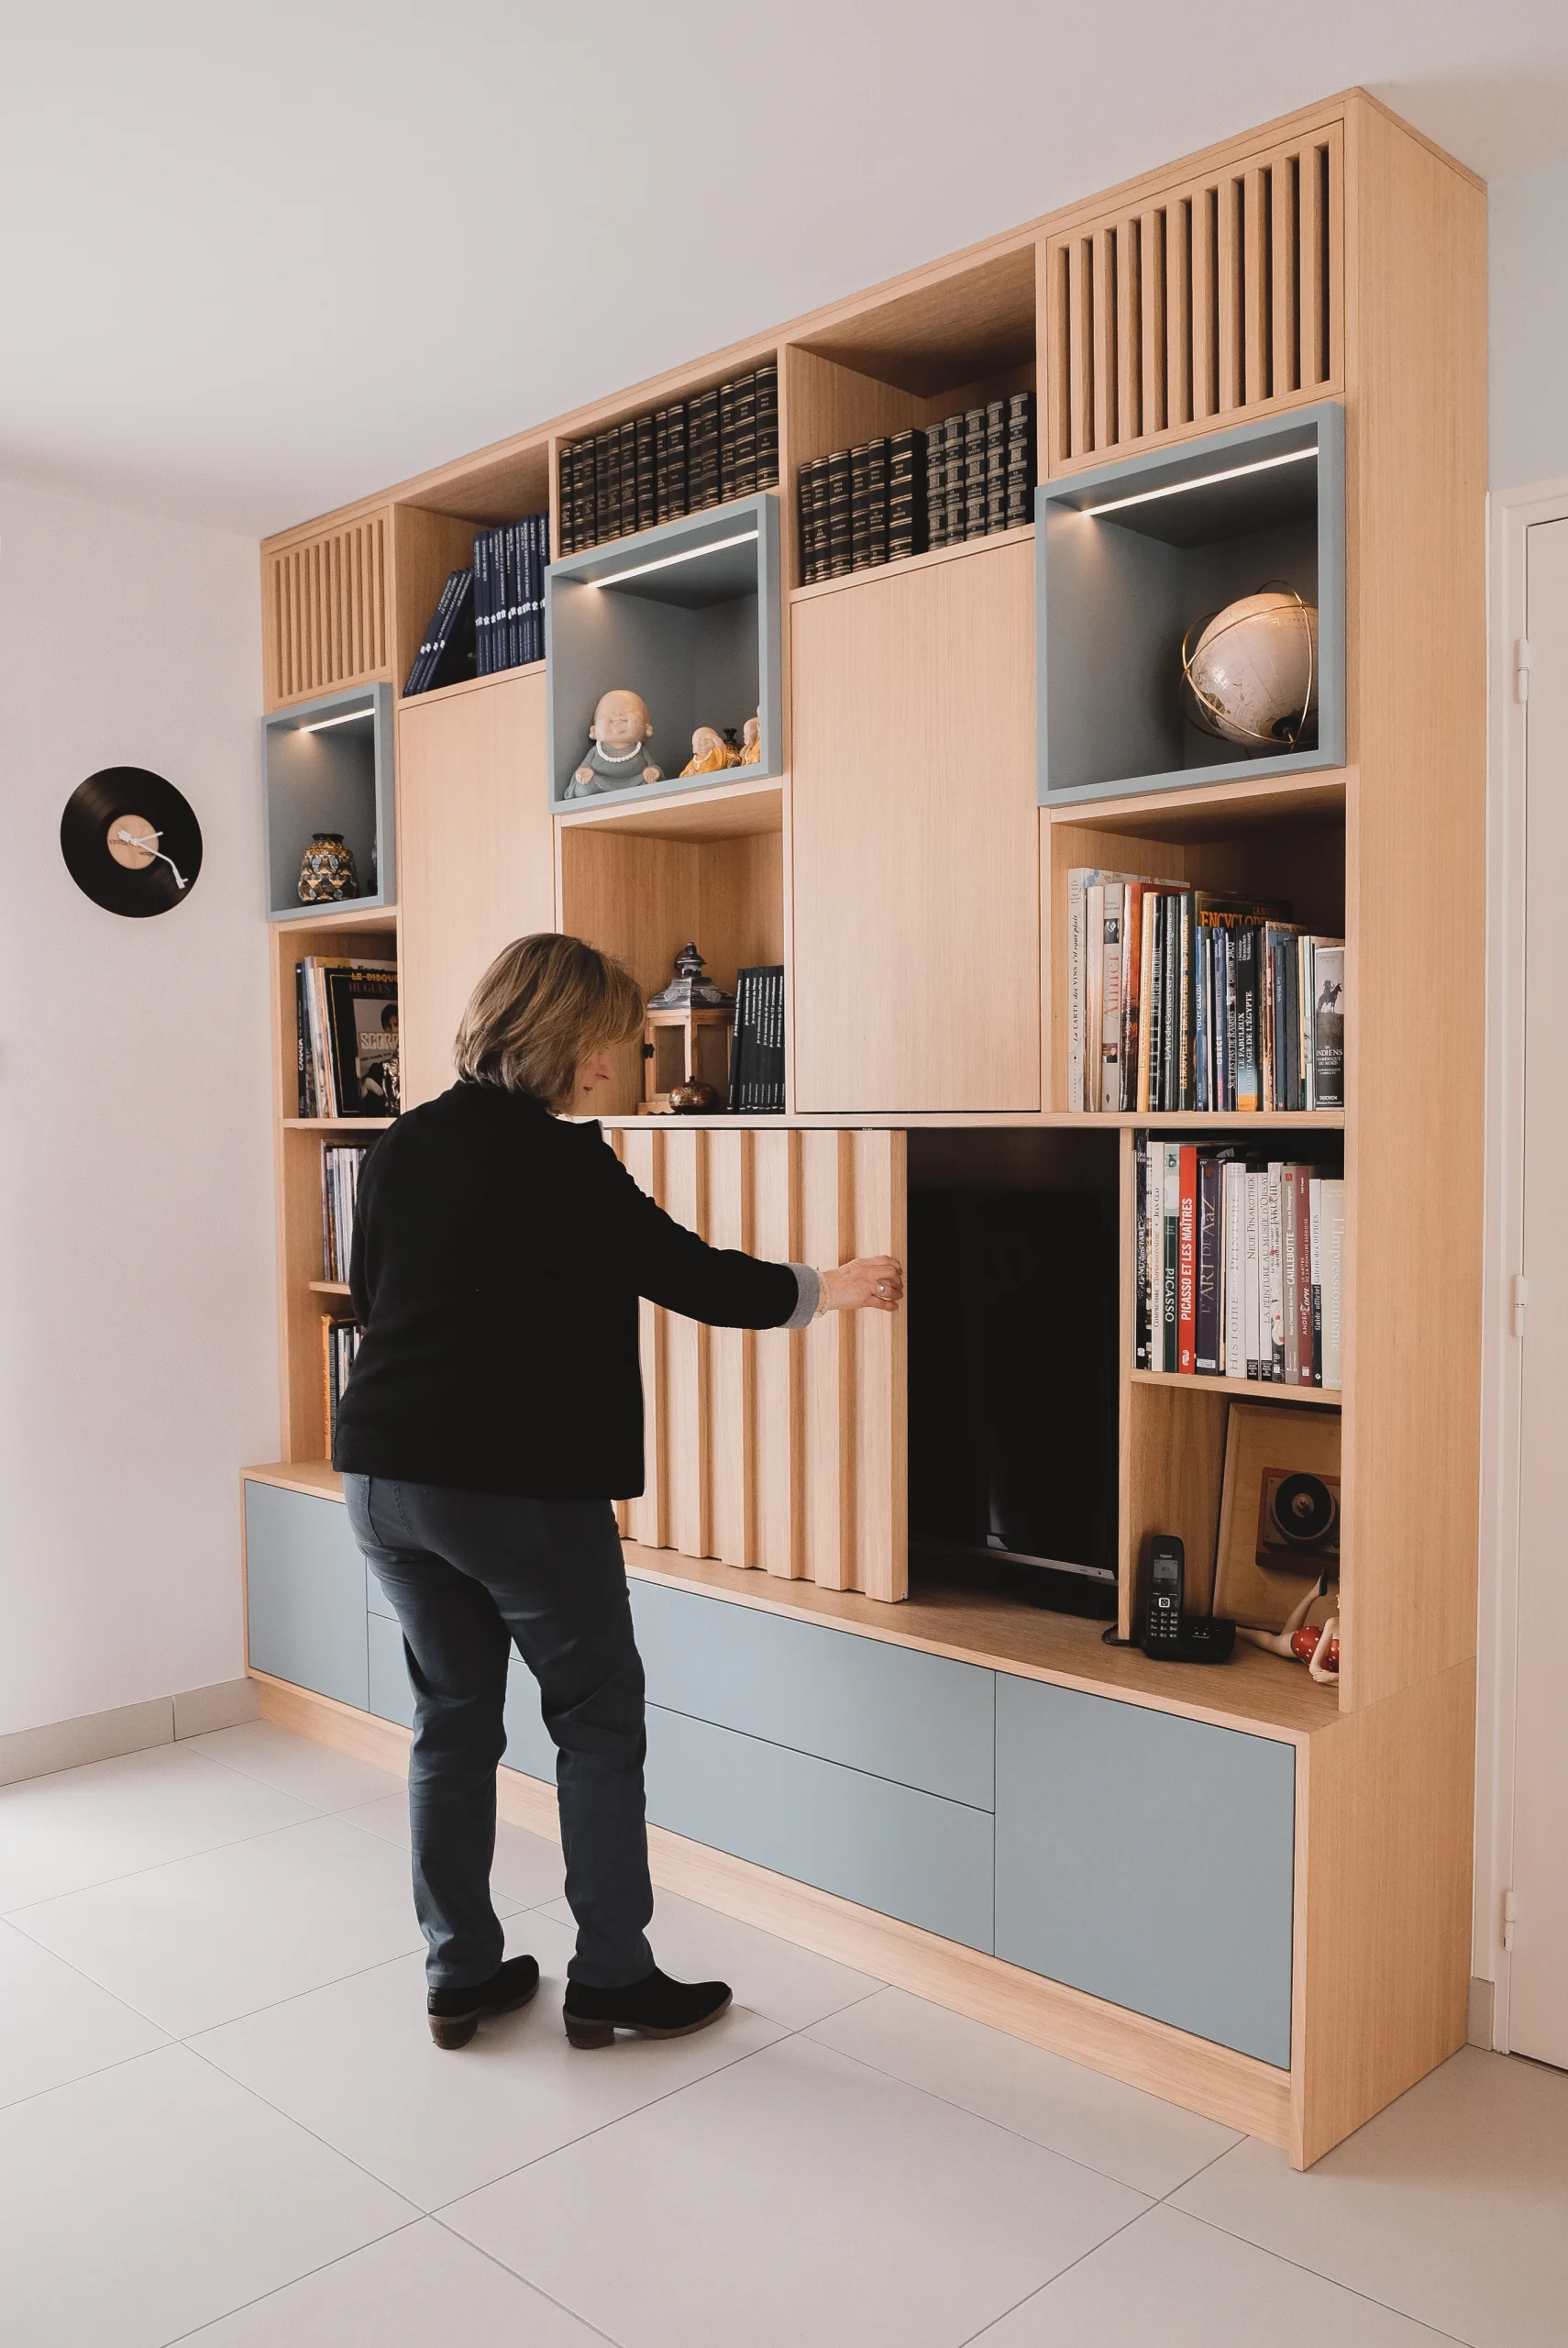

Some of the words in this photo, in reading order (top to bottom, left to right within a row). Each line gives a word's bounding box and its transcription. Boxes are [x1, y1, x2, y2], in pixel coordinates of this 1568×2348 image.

[1165, 912, 1174, 946] légumes
[1165, 945, 1173, 954] et
[1227, 941, 1235, 958] JACQ
[351, 972, 362, 980] LE
[1165, 955, 1174, 978] fruits
[348, 982, 392, 991] HUGUES
[1103, 957, 1120, 1020] Aimer
[1164, 980, 1172, 1024] Conserver
[1243, 991, 1253, 1032] L'ÉGYPTE
[1072, 1033, 1078, 1042] La
[1164, 1024, 1172, 1036] de
[1245, 1033, 1253, 1045] DE
[1164, 1037, 1172, 1060] L'Art
[1228, 1039, 1236, 1048] DE
[1228, 1049, 1236, 1061] PAS
[1228, 1061, 1236, 1074] LES
[1238, 1058, 1245, 1069] LE
[1180, 1078, 1187, 1090] LA
[1227, 1074, 1236, 1090] SUR
[1246, 1176, 1255, 1233] PINAKOTHEK
[1259, 1176, 1269, 1214] D'ORSAY
[1178, 1198, 1192, 1241] MAÎTRES
[1229, 1195, 1240, 1270] PEINTURE
[1260, 1217, 1269, 1247] MUSÉE
[1137, 1246, 1145, 1261] dans
[1180, 1244, 1192, 1261] LES
[1201, 1238, 1211, 1257] DE
[1246, 1235, 1256, 1260] NEUE
[1262, 1249, 1270, 1263] AU
[1286, 1232, 1295, 1285] CAILLEBOTTE
[1137, 1263, 1145, 1275] NU
[1180, 1263, 1192, 1276] ET
[1312, 1260, 1320, 1284] Galerie
[1165, 1268, 1175, 1323] PICASSO
[1200, 1264, 1215, 1313] L'ART
[1262, 1266, 1271, 1309] PEINTURE
[1328, 1217, 1344, 1352] L'Impressionnisme
[1180, 1279, 1192, 1321] PICASSO
[1299, 1286, 1310, 1314] Zorn
[1263, 1312, 1271, 1324] LA
[1229, 1296, 1239, 1371] HISTOIRE
